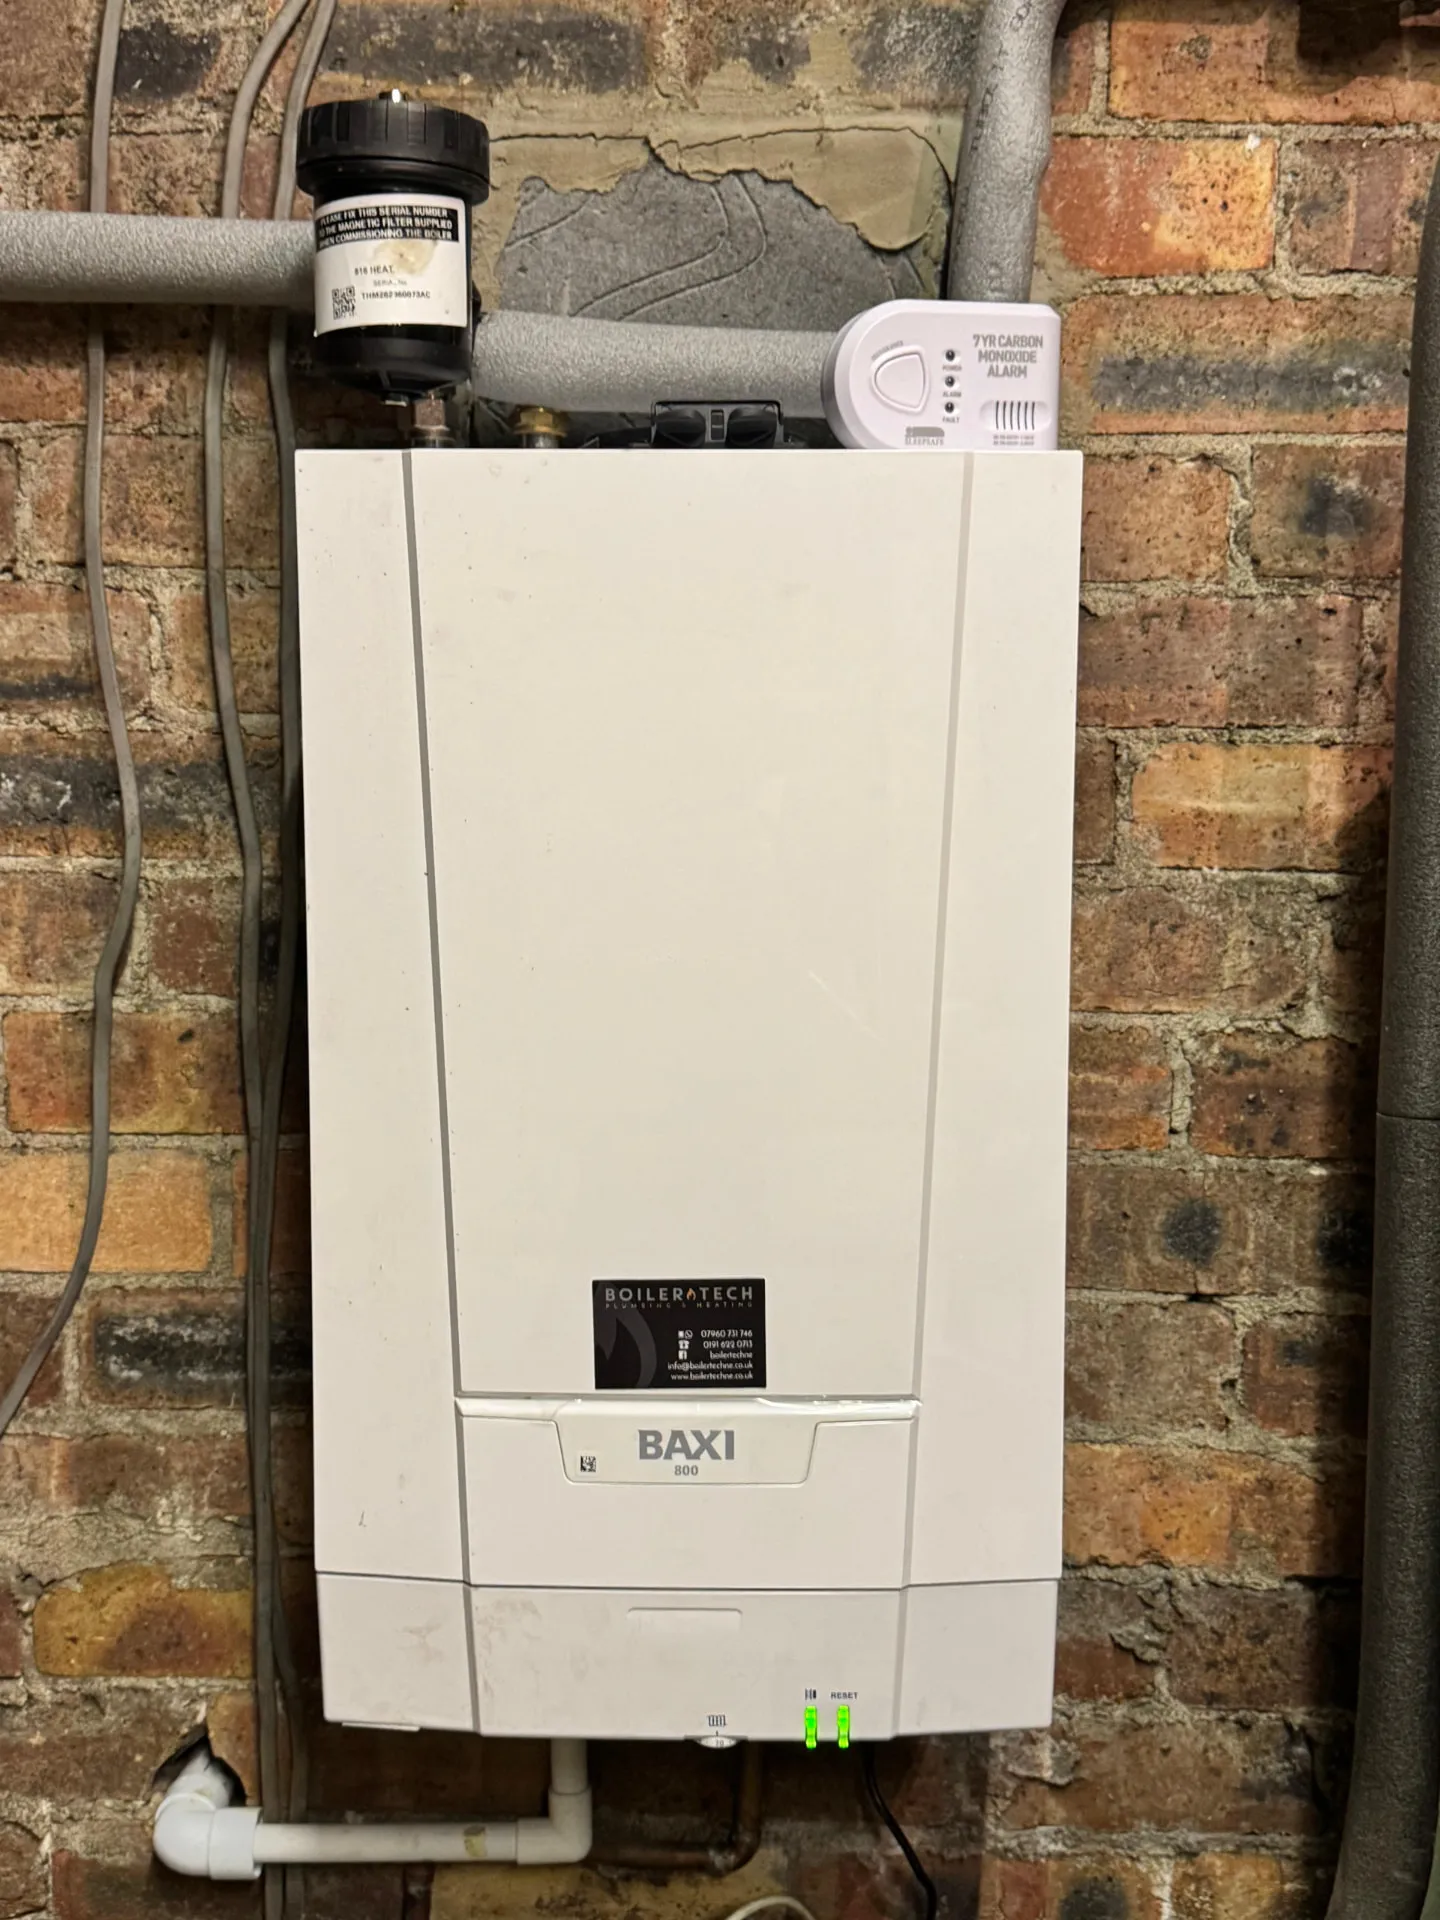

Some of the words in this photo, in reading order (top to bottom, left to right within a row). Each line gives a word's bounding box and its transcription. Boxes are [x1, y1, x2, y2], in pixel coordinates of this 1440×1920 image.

[343, 209, 356, 219] FIX
[358, 207, 377, 217] THIS
[379, 205, 411, 216] SERIAL
[413, 206, 448, 218] NUMBER
[338, 217, 380, 231] MAGNETIC
[382, 216, 413, 227] FILTER
[414, 217, 453, 229] SUPPLIED
[335, 227, 403, 244] COMMISSIONING
[405, 228, 422, 238] THE
[424, 229, 452, 240] BOILER
[998, 335, 1044, 348] CARBON
[978, 349, 1037, 363] MONOXIDE
[987, 364, 1027, 378] ALARM
[605, 1287, 684, 1302] BOILER
[699, 1286, 753, 1301] TECH
[696, 1301, 753, 1309] HEATING
[700, 1329, 726, 1338] 07960
[727, 1329, 739, 1337] 731
[740, 1329, 753, 1338] 746
[703, 1340, 719, 1349] 0191
[638, 1430, 735, 1460] BAXI
[674, 1465, 699, 1476] 800
[830, 1691, 858, 1700] RESET
